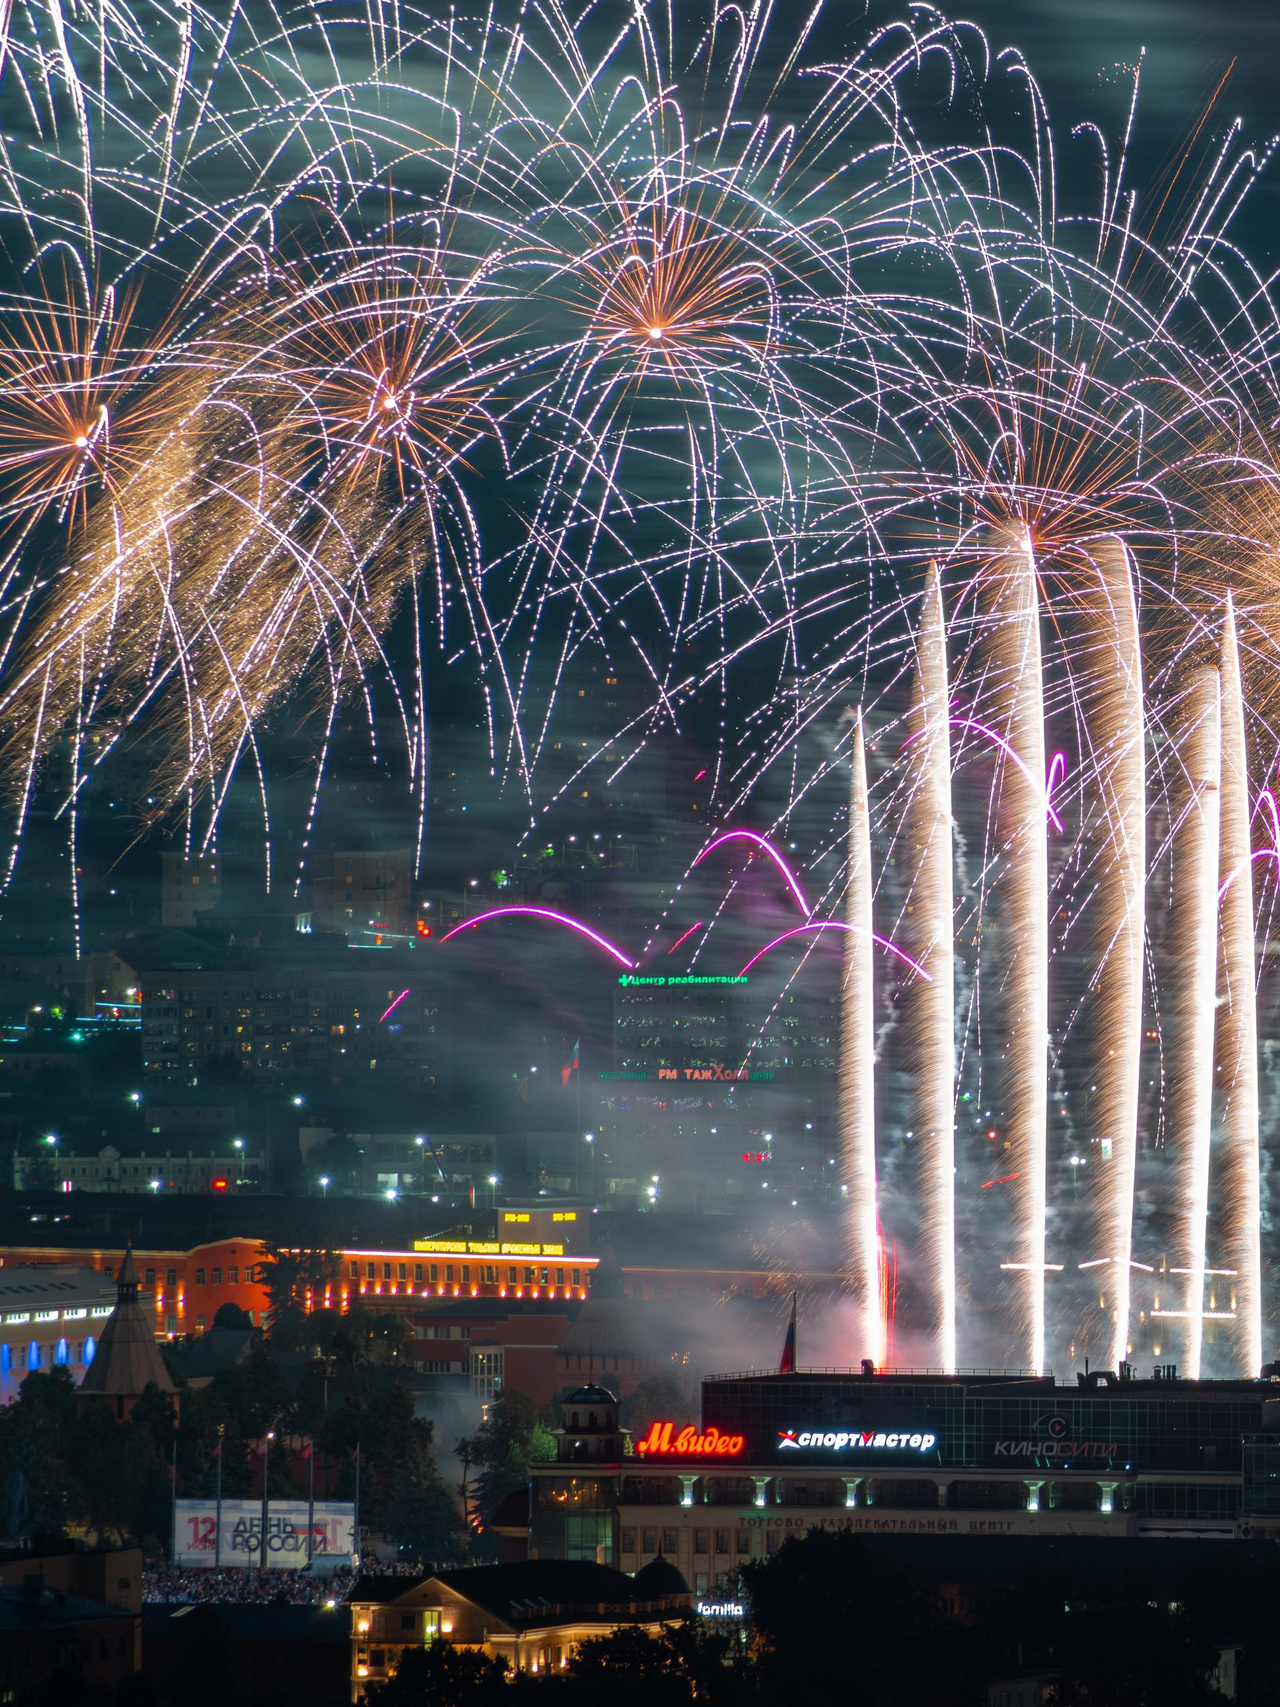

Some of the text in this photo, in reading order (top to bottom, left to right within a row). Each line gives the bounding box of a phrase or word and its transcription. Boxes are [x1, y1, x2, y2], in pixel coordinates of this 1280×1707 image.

[631, 975, 748, 986] Центр реабилитации
[750, 1072, 775, 1081] ЦЕНТР
[638, 1422, 744, 1453] М.видео
[188, 1516, 216, 1544] 12
[233, 1516, 295, 1534] ДЕНЬ
[738, 1517, 804, 1528] ТОРГОВО
[232, 1534, 327, 1552] РОССИИ
